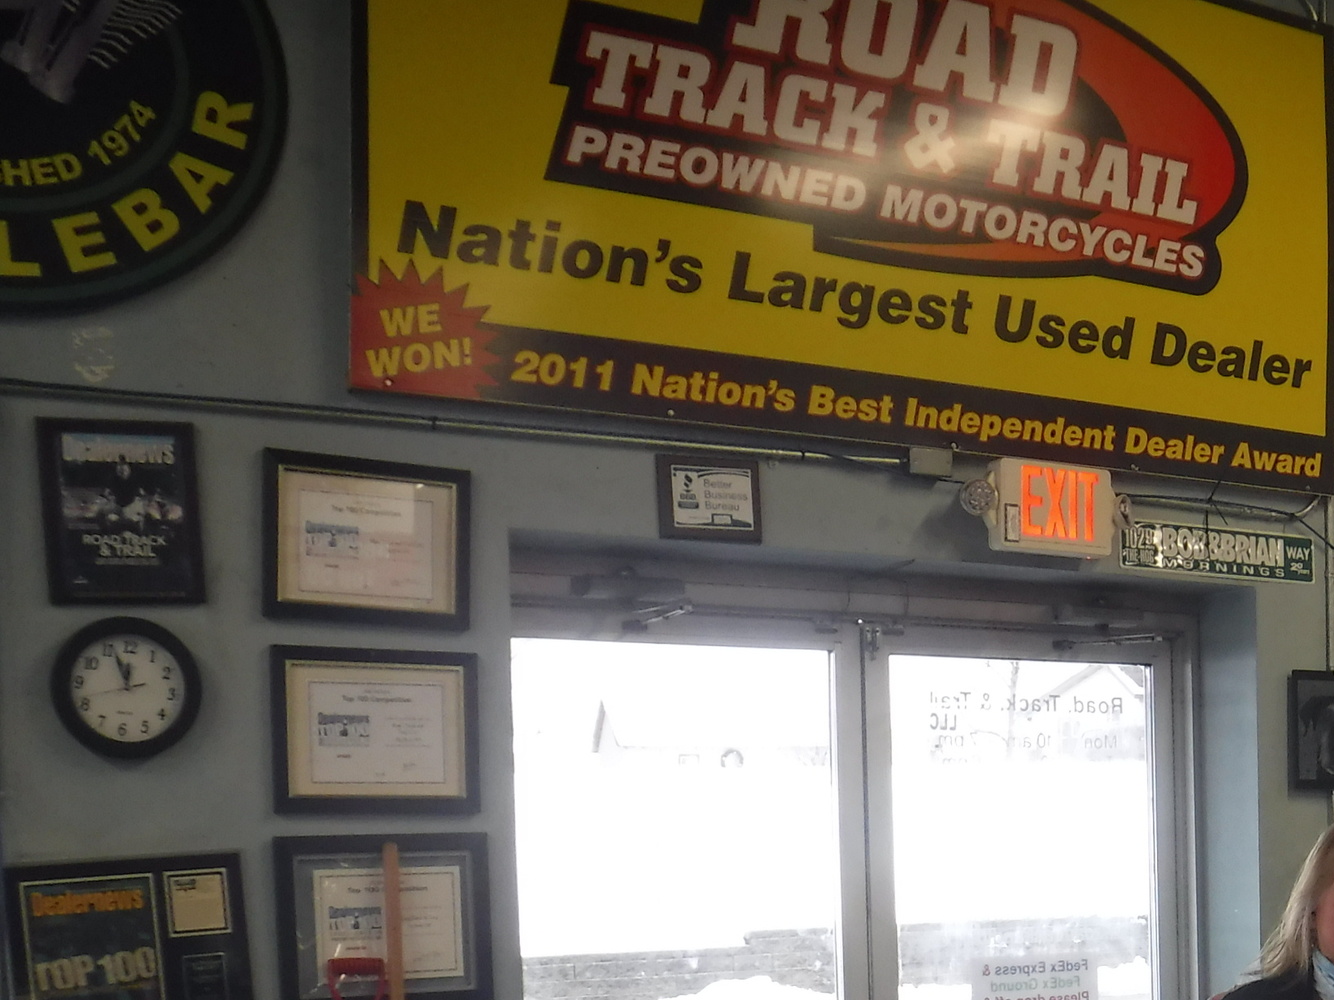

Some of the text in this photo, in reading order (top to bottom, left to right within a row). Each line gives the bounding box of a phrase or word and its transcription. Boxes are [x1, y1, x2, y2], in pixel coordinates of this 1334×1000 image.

[733, 0, 1078, 117] ROAD
[0, 100, 157, 187] HED 1974
[586, 31, 1198, 225] TRACK & TRAIL
[566, 125, 1205, 278] PREOWNED MOTORCYCLES
[379, 304, 441, 337] WE
[397, 200, 1312, 388] Nation's Largest Used Dealer
[365, 337, 471, 378] WON!
[510, 350, 1322, 477] 2011 Nation's Best Independent Dealer Award
[1021, 465, 1099, 542] EXIT
[1162, 558, 1285, 577] MORNINGS
[1286, 546, 1310, 560] WAY
[35, 946, 157, 992] TOP 100
